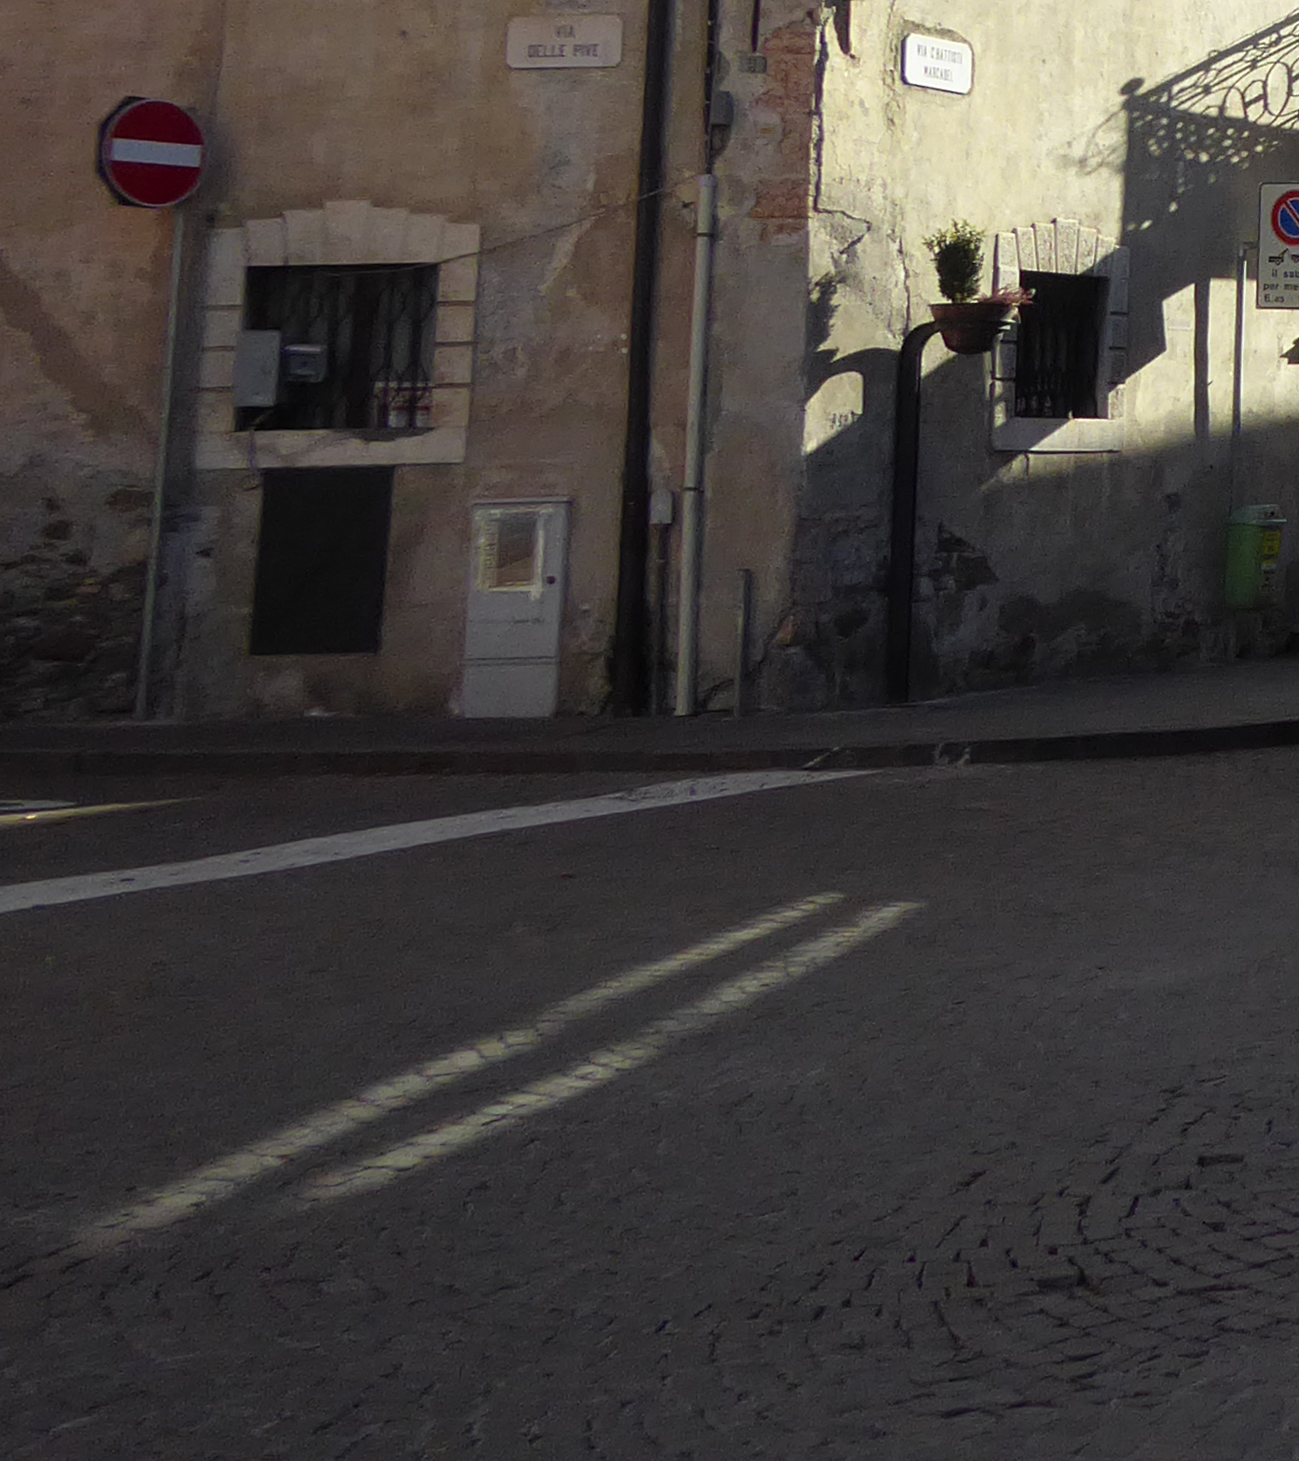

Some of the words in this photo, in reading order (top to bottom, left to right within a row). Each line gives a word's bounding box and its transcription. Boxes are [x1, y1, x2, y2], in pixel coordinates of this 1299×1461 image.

[555, 24, 577, 38] VIA
[1271, 269, 1278, 278] il
[1263, 283, 1280, 291] per
